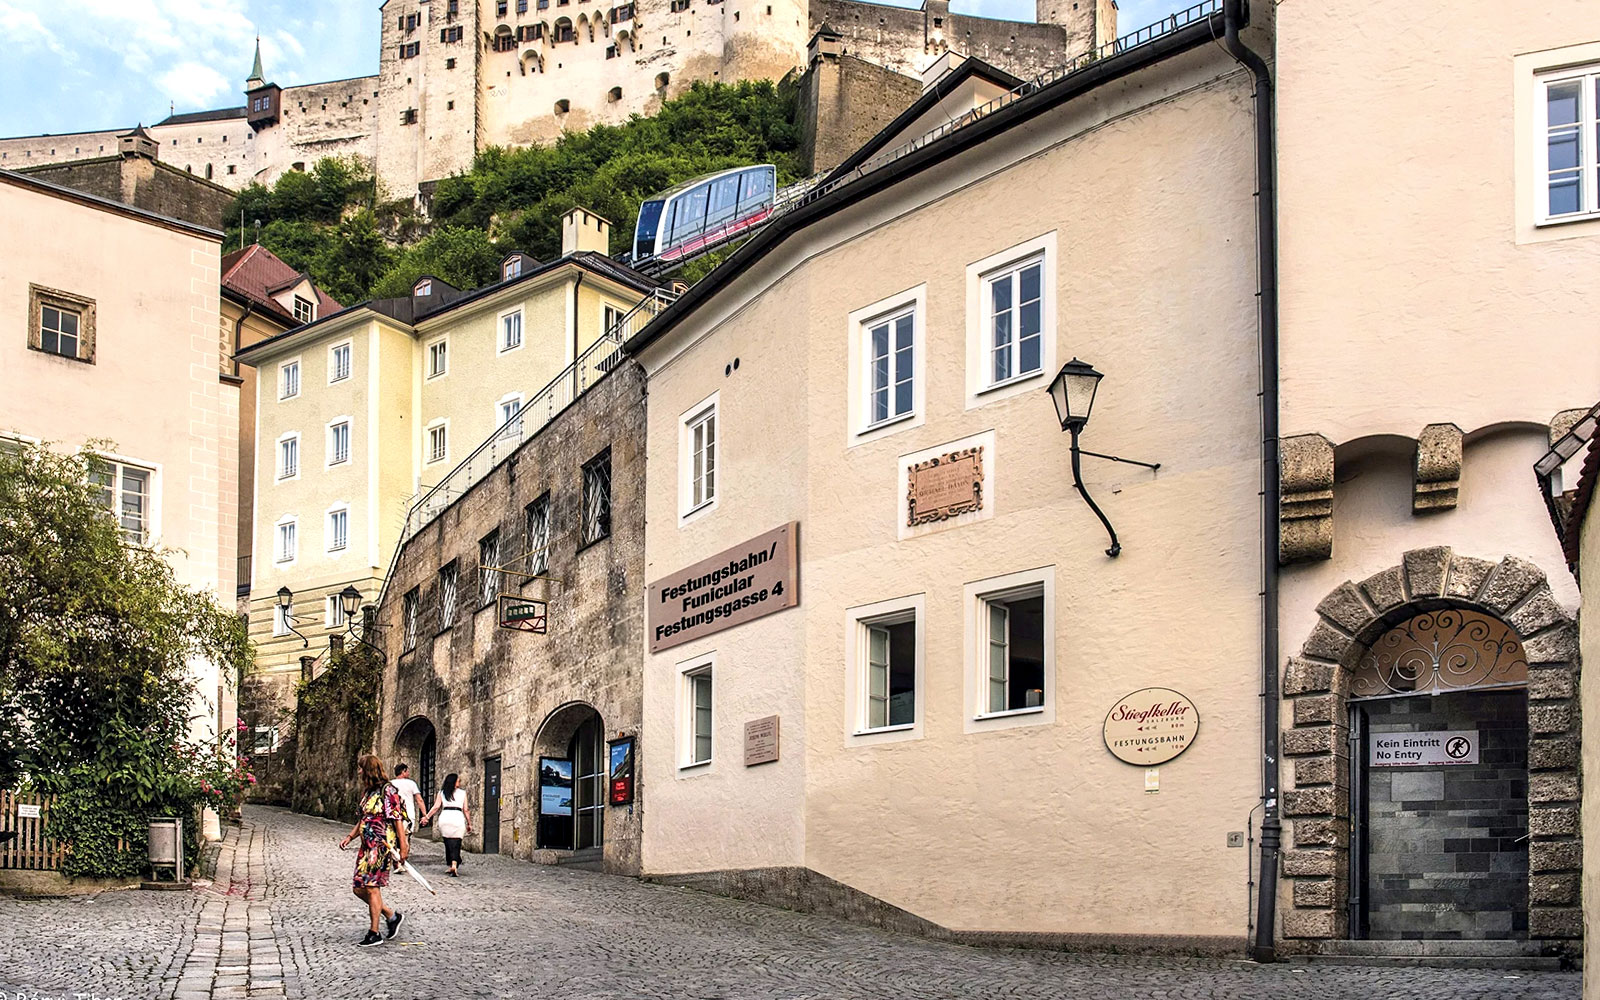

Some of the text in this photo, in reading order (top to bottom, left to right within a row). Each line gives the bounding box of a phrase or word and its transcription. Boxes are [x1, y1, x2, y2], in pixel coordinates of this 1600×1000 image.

[661, 541, 777, 603] Festungsbahn/
[682, 574, 755, 612] Funicular
[655, 580, 784, 641] Festungsgasse 4
[1111, 701, 1190, 724] Stieglkeller
[1146, 716, 1185, 724] SALZBURG
[1114, 735, 1185, 747] FESTUNGSBAHN
[1376, 738, 1441, 749] Kein Eintritt
[1376, 751, 1423, 761] No Entry
